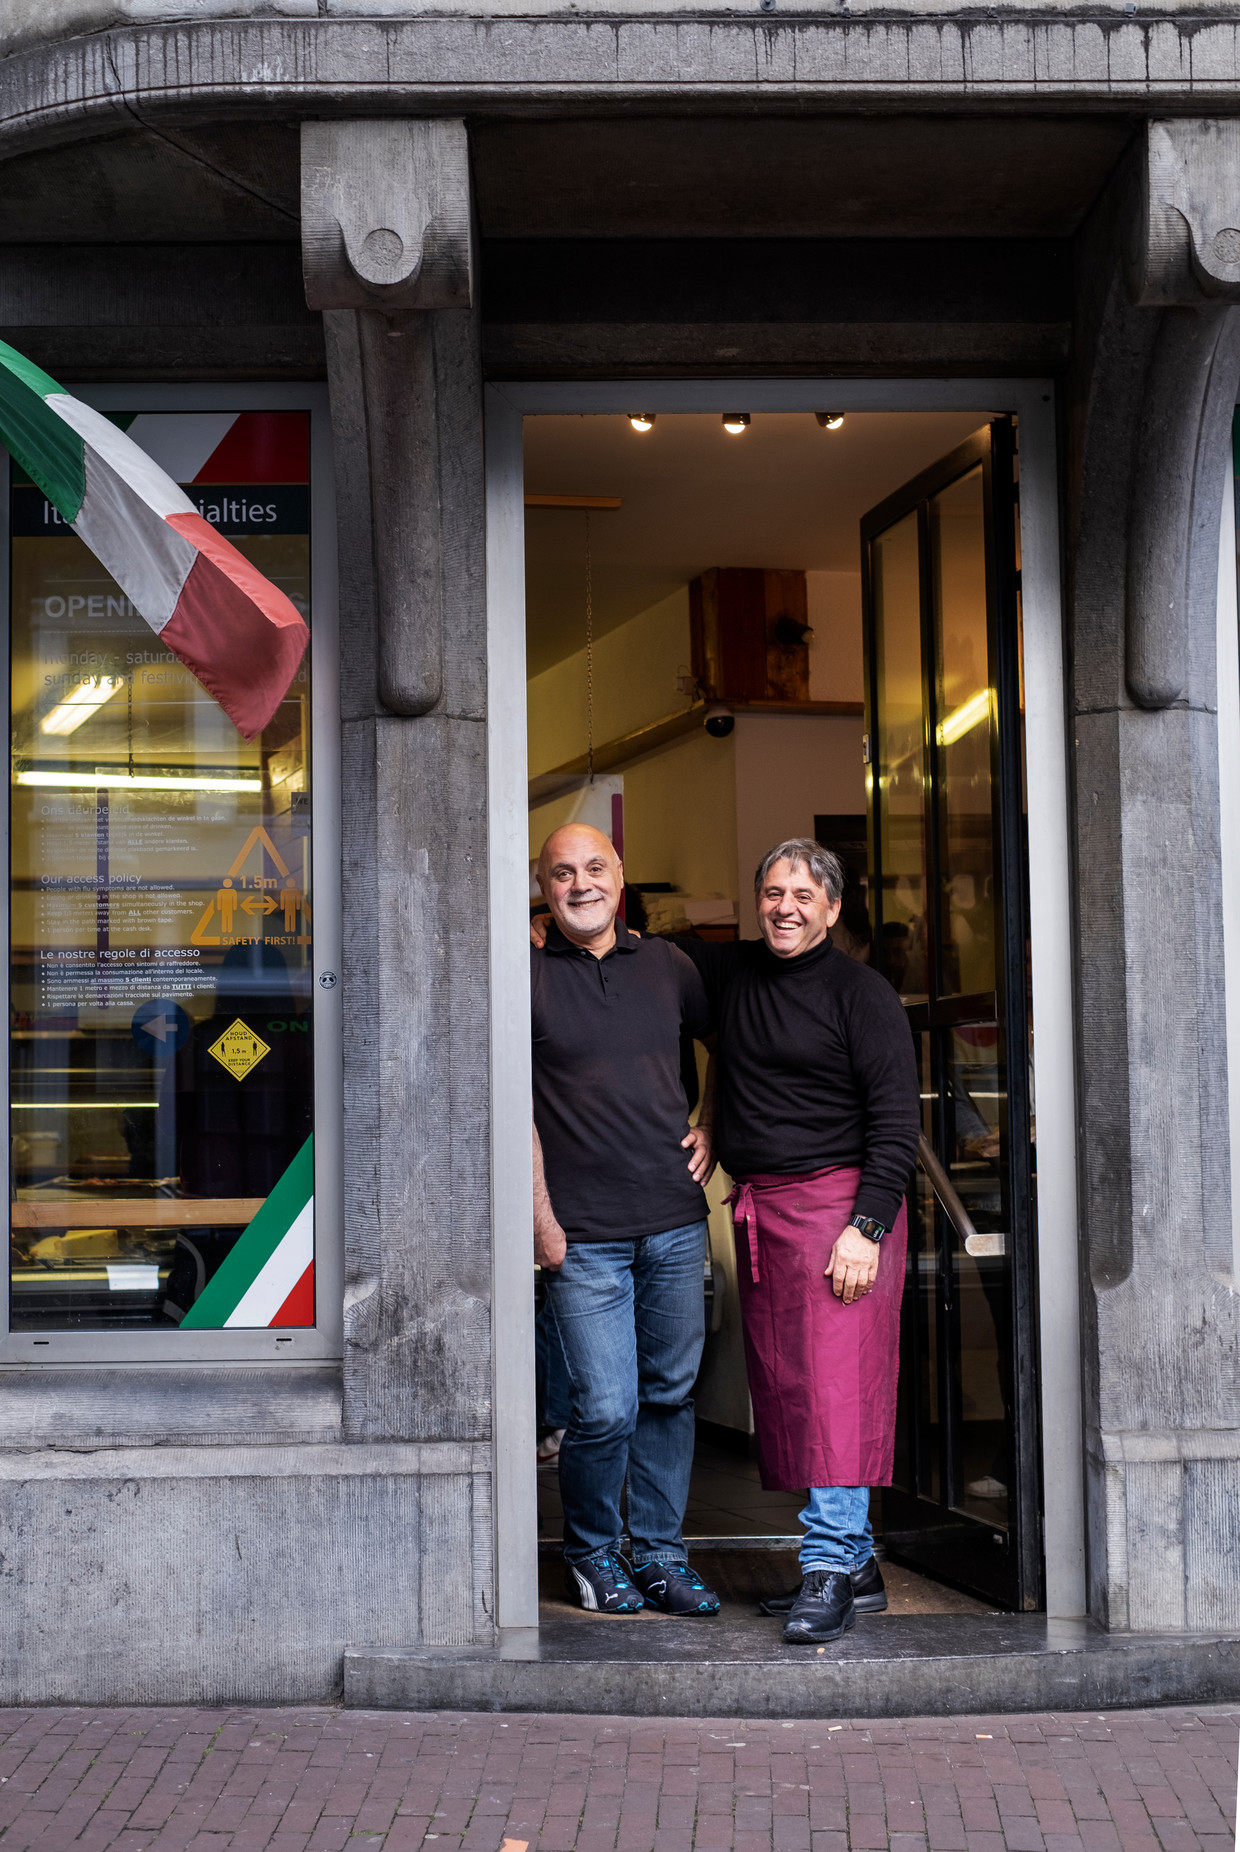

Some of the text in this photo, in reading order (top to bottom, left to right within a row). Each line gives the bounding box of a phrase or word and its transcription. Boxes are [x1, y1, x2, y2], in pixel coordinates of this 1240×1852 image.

[44, 672, 98, 688] sunday
[41, 806, 64, 815] Ons
[41, 873, 142, 884] Our access policy
[240, 875, 277, 888] 1.5m
[222, 936, 296, 945] SAFETY FIRST!
[40, 948, 201, 960] Le nostre regole di accesso
